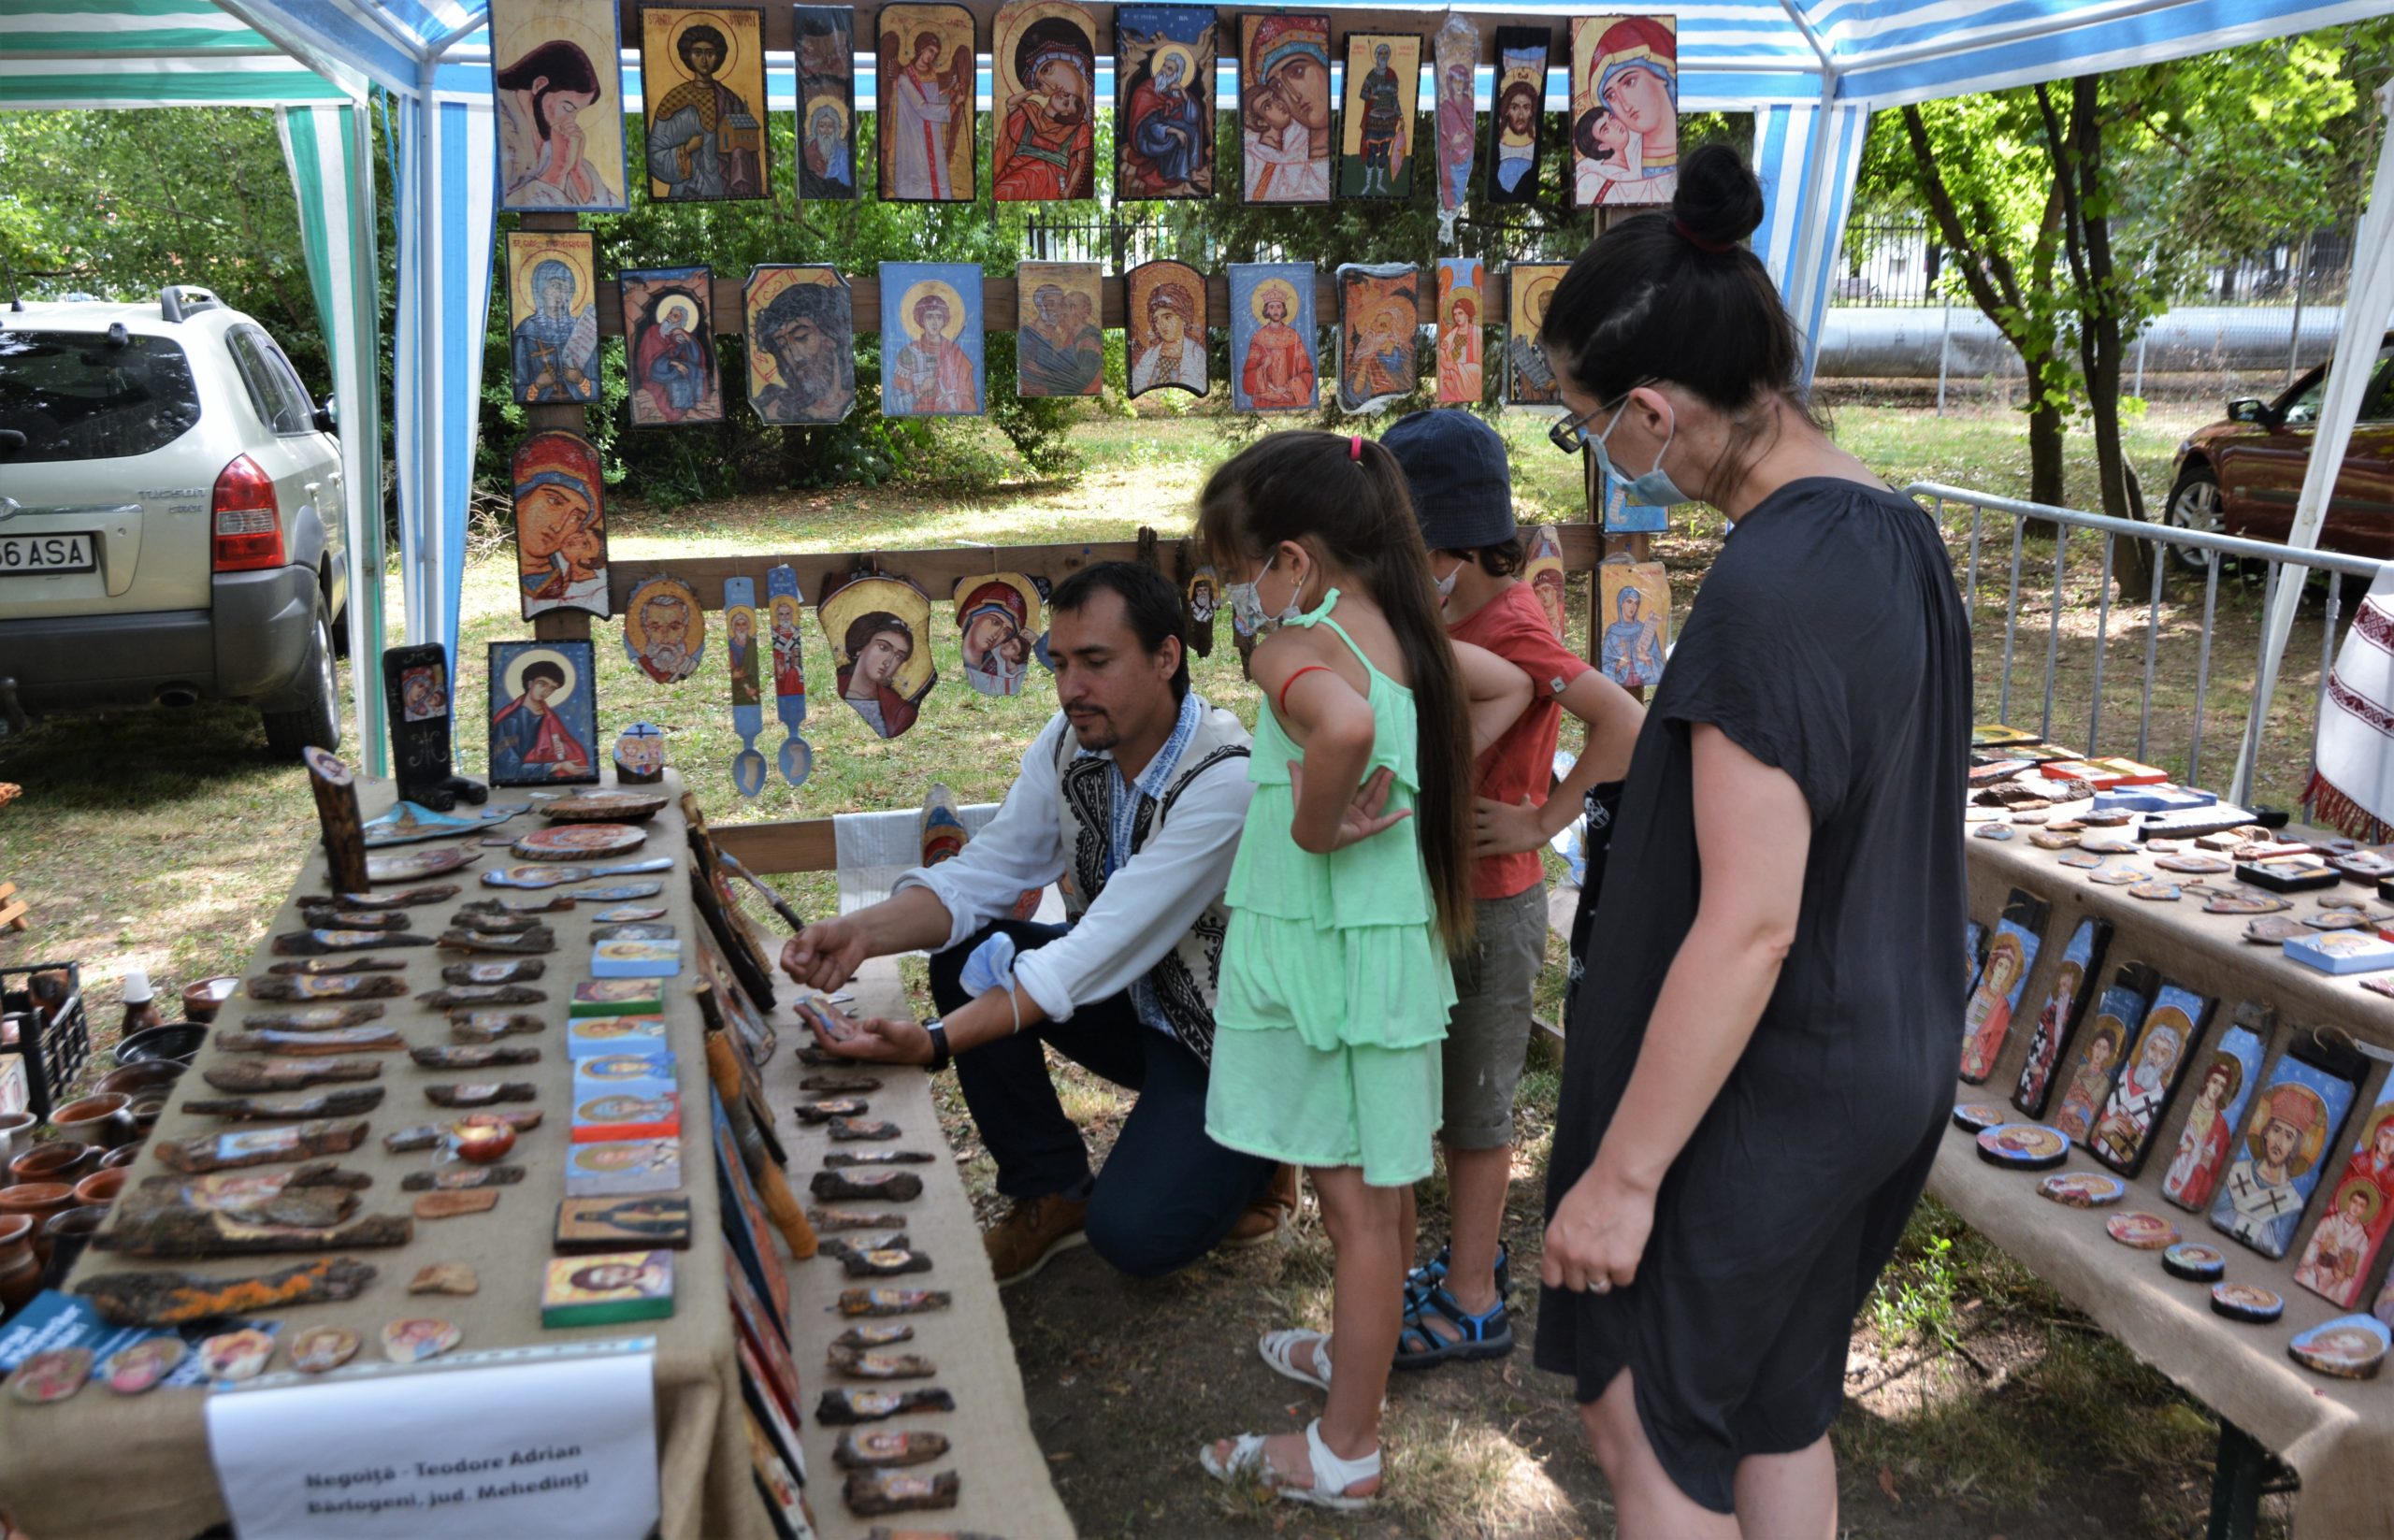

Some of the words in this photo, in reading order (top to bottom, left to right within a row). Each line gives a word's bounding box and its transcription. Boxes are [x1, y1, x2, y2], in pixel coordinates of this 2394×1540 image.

[0, 540, 21, 567] 6
[29, 538, 84, 566] ASA
[414, 1456, 504, 1478] Teodore
[510, 1445, 582, 1467] Adrian
